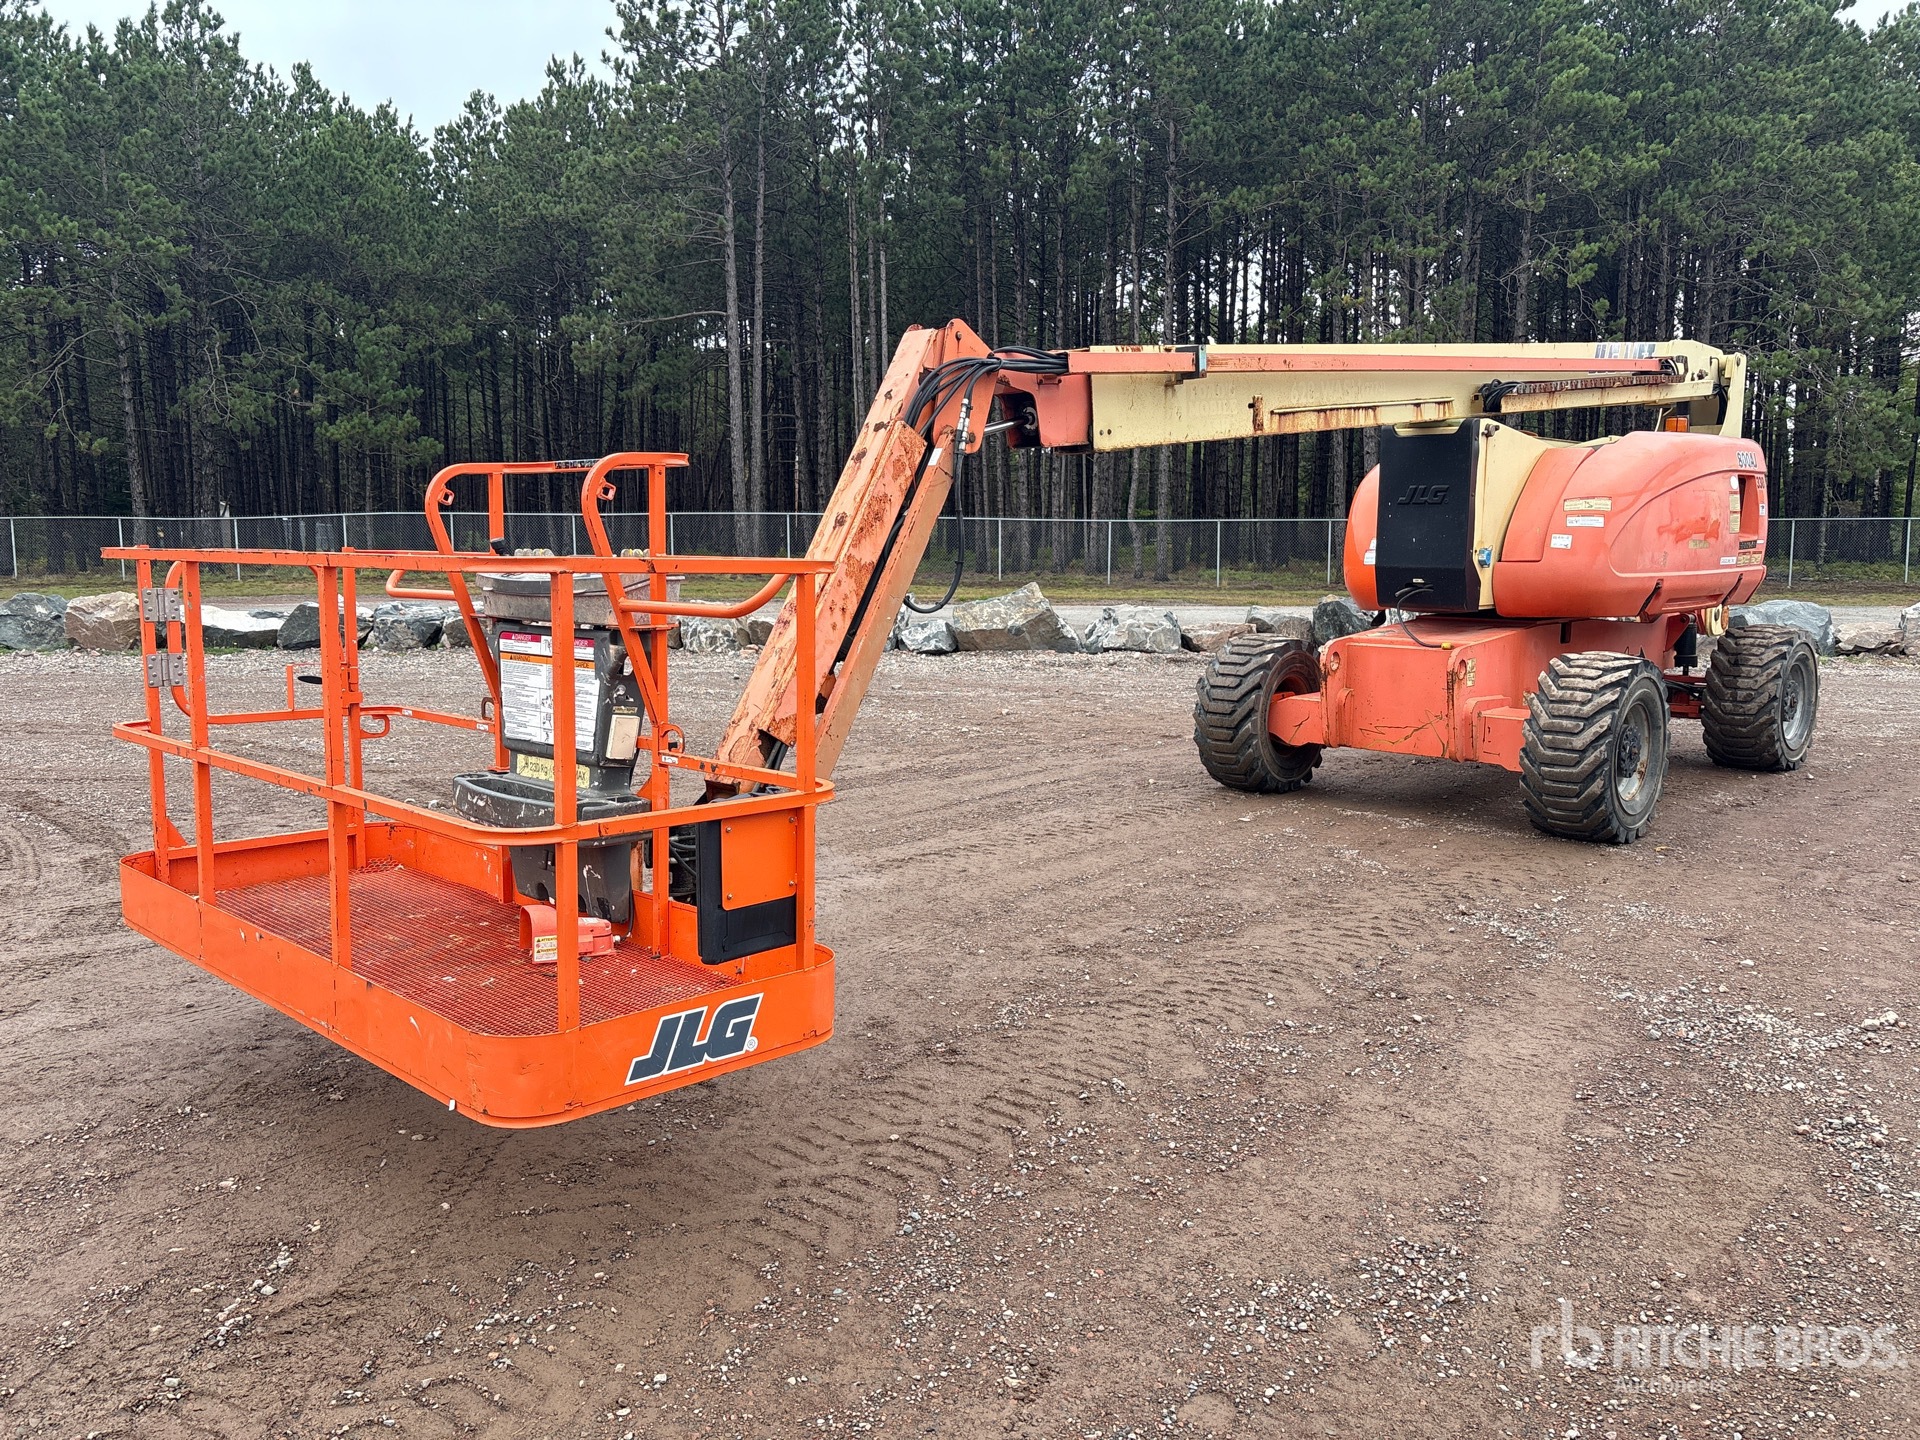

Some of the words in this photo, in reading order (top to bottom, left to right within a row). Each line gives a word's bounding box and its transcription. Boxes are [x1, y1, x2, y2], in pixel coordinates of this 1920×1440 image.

[1397, 485, 1449, 505] JLG
[514, 633, 532, 641] DANGER
[624, 992, 765, 1086] JLG
